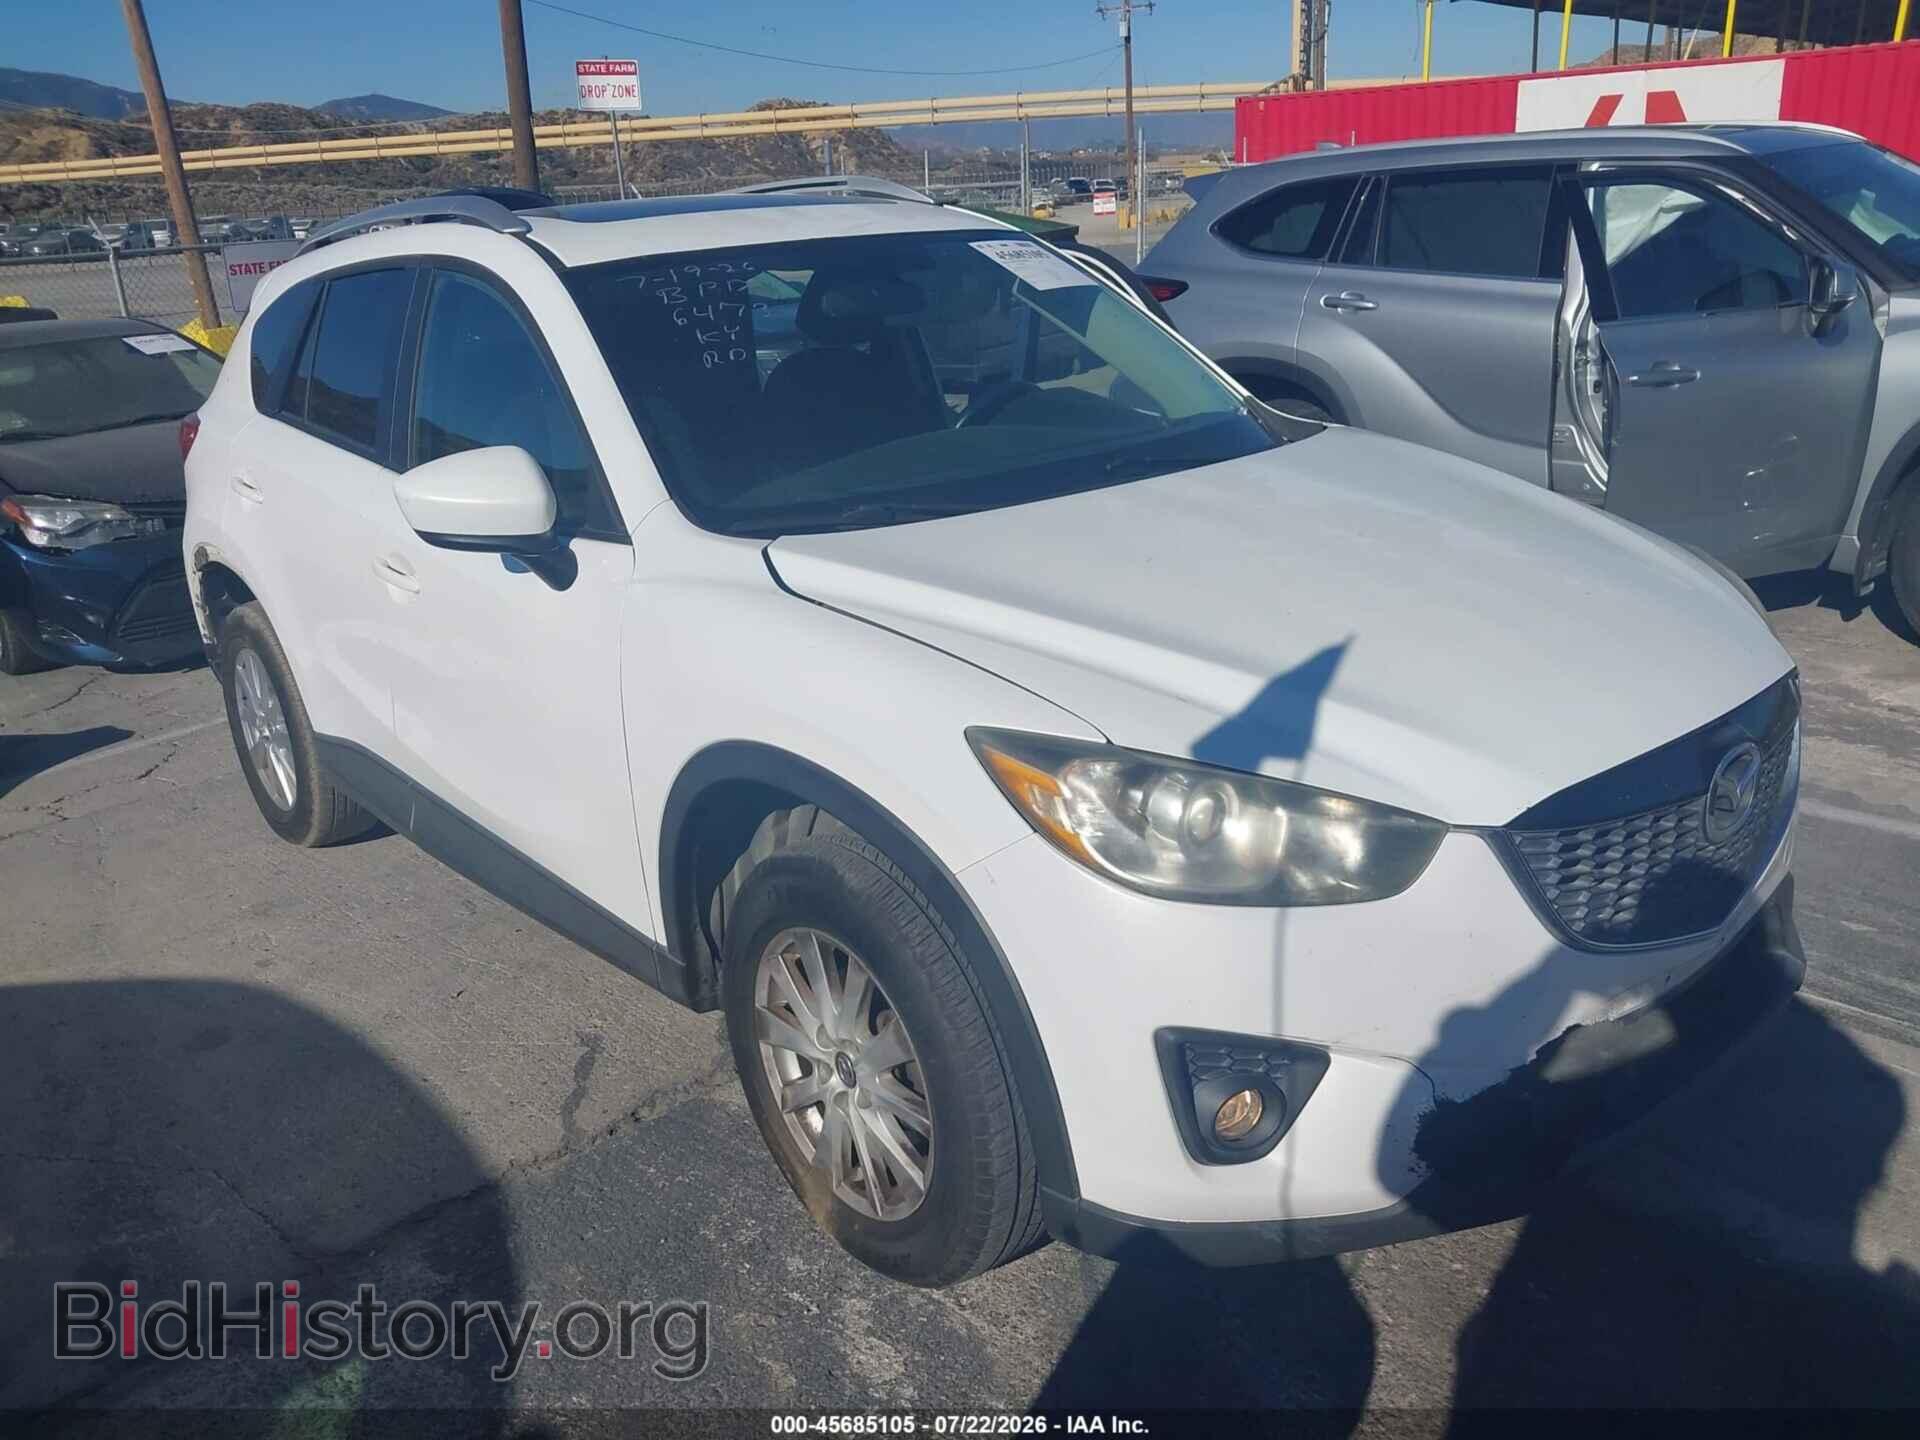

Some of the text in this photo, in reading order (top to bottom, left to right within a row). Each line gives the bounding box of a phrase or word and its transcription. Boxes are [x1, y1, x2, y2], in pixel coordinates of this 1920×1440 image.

[578, 64, 635, 73] STATE FARM
[581, 84, 637, 98] DROP ZONE
[228, 262, 266, 276] STATE
